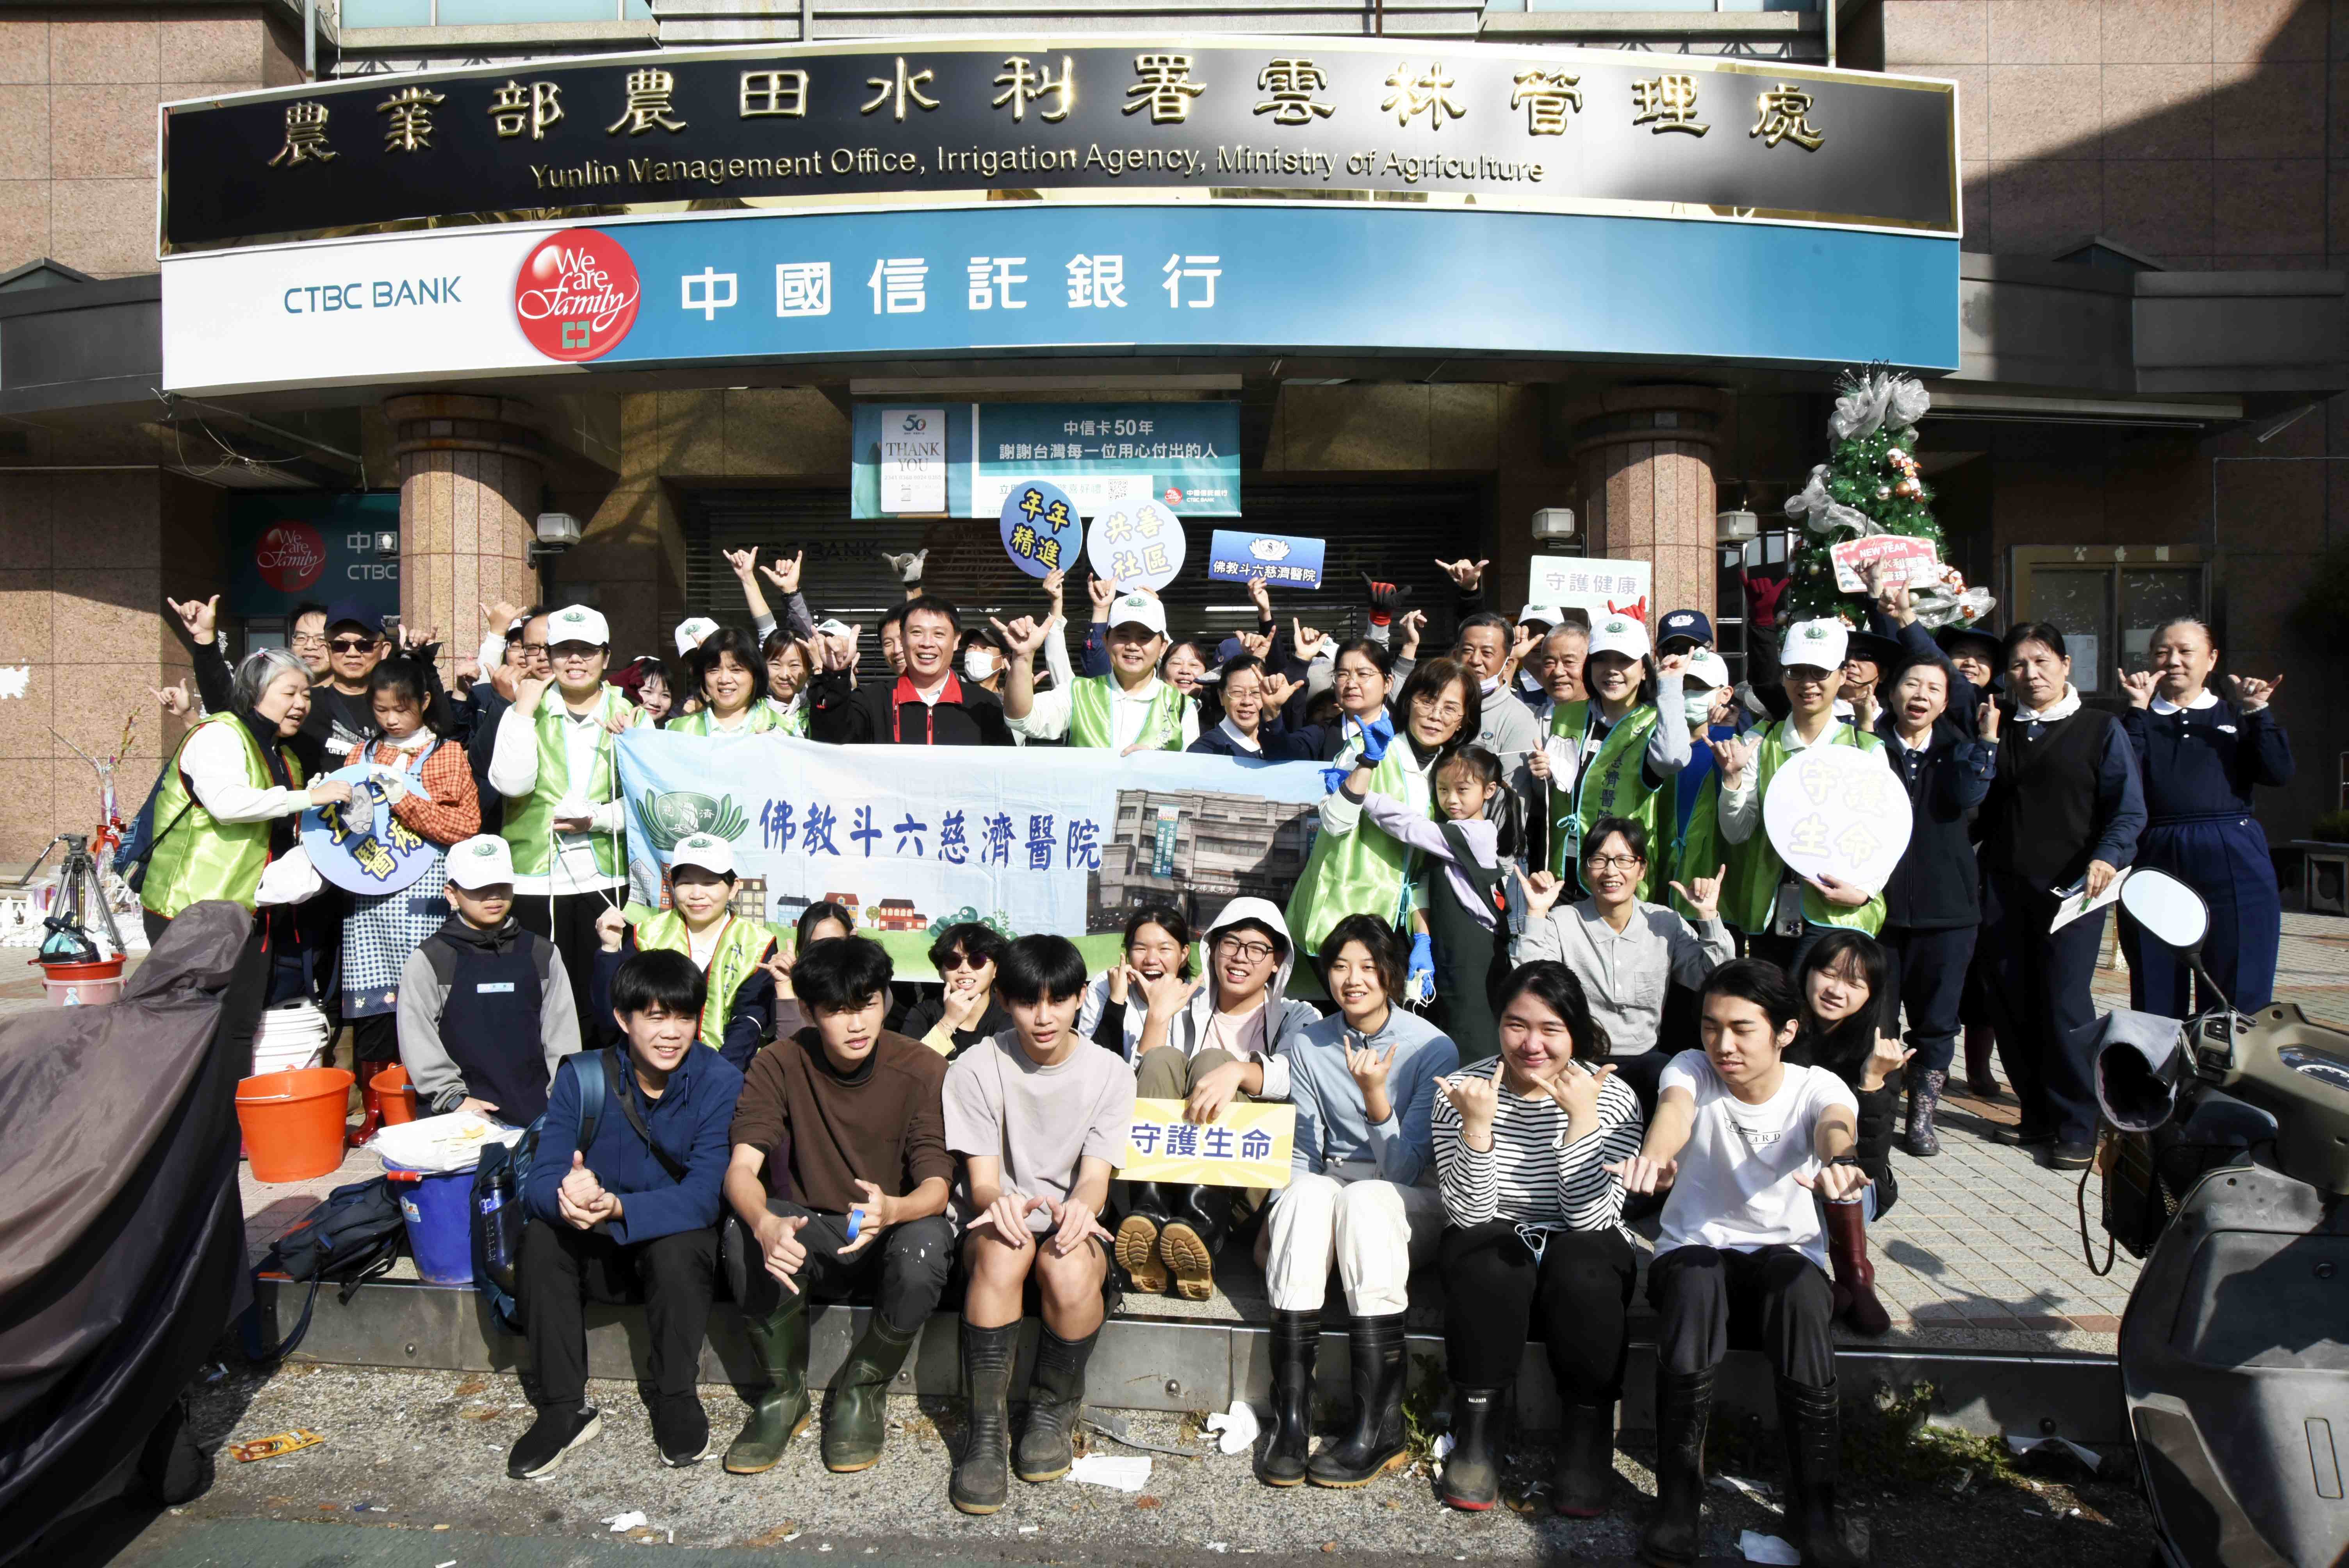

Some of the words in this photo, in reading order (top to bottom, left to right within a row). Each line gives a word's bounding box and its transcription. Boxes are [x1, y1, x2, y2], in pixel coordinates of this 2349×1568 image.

[268, 53, 1825, 169] 農業部農田水利署雲林管理處
[529, 159, 620, 190] Yunlin
[627, 148, 823, 186] Management
[832, 146, 926, 176] Office,
[938, 145, 1076, 177] Irrigation
[1086, 144, 1205, 175] Agency,
[1217, 146, 1337, 180] Ministry
[1346, 148, 1377, 175] of
[1382, 150, 1545, 183] Agriculture
[552, 247, 597, 273] We
[570, 269, 609, 290] are
[682, 254, 1222, 320] 中國信託銀行
[283, 281, 362, 314] CTBC
[372, 274, 462, 308] BANK
[517, 271, 640, 332] Family
[902, 414, 927, 432] 50
[1064, 419, 1154, 436] 中信卡50年
[886, 442, 940, 456] THANK
[999, 443, 1219, 460] 謝謝台灣每一位用心付出的人
[898, 458, 929, 472] YOU
[1018, 487, 1071, 534] 年年
[1104, 505, 1164, 543] 共善
[280, 530, 302, 543] We
[347, 531, 397, 554] 中國
[1010, 525, 1062, 571] 精進
[1859, 547, 1881, 558] NEW
[1882, 542, 1907, 554] YEAR
[257, 547, 326, 577] Family
[347, 565, 397, 580] CTBC
[1111, 543, 1171, 582] 社區
[1213, 560, 1316, 582] 佛教斗六慈濟醫院
[1545, 572, 1637, 595] 守護健康
[759, 796, 1104, 873] 佛教斗六慈濟醫院
[1787, 811, 1883, 869] 生命
[1131, 1123, 1272, 1160] 守護生命
